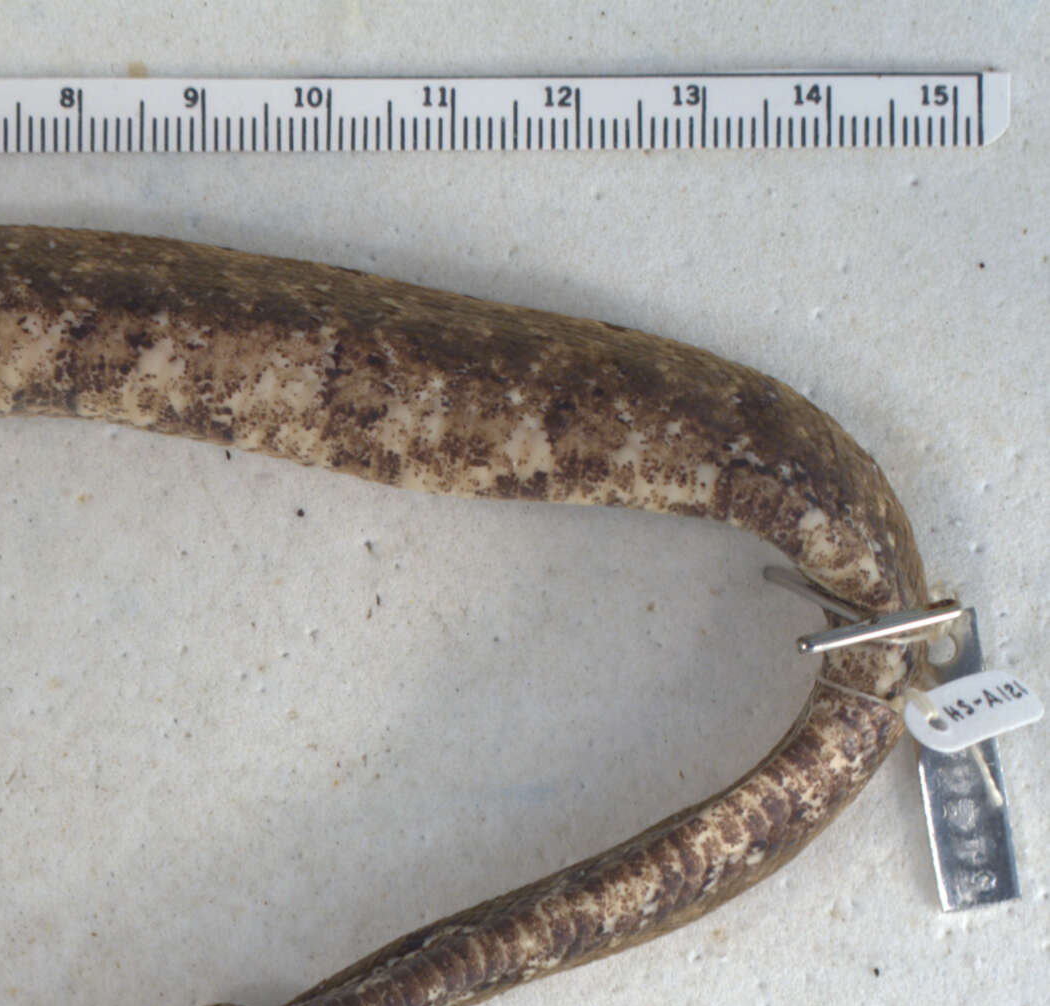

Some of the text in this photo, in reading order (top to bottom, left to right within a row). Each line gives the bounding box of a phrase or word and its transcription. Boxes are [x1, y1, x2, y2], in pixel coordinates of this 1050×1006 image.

[59, 87, 75, 108] 8
[183, 87, 199, 108] 9
[295, 87, 323, 108] 10
[423, 86, 448, 107] 11
[545, 86, 572, 107] 12
[673, 84, 700, 106] 13
[794, 84, 822, 105] 14
[921, 85, 949, 106] 15
